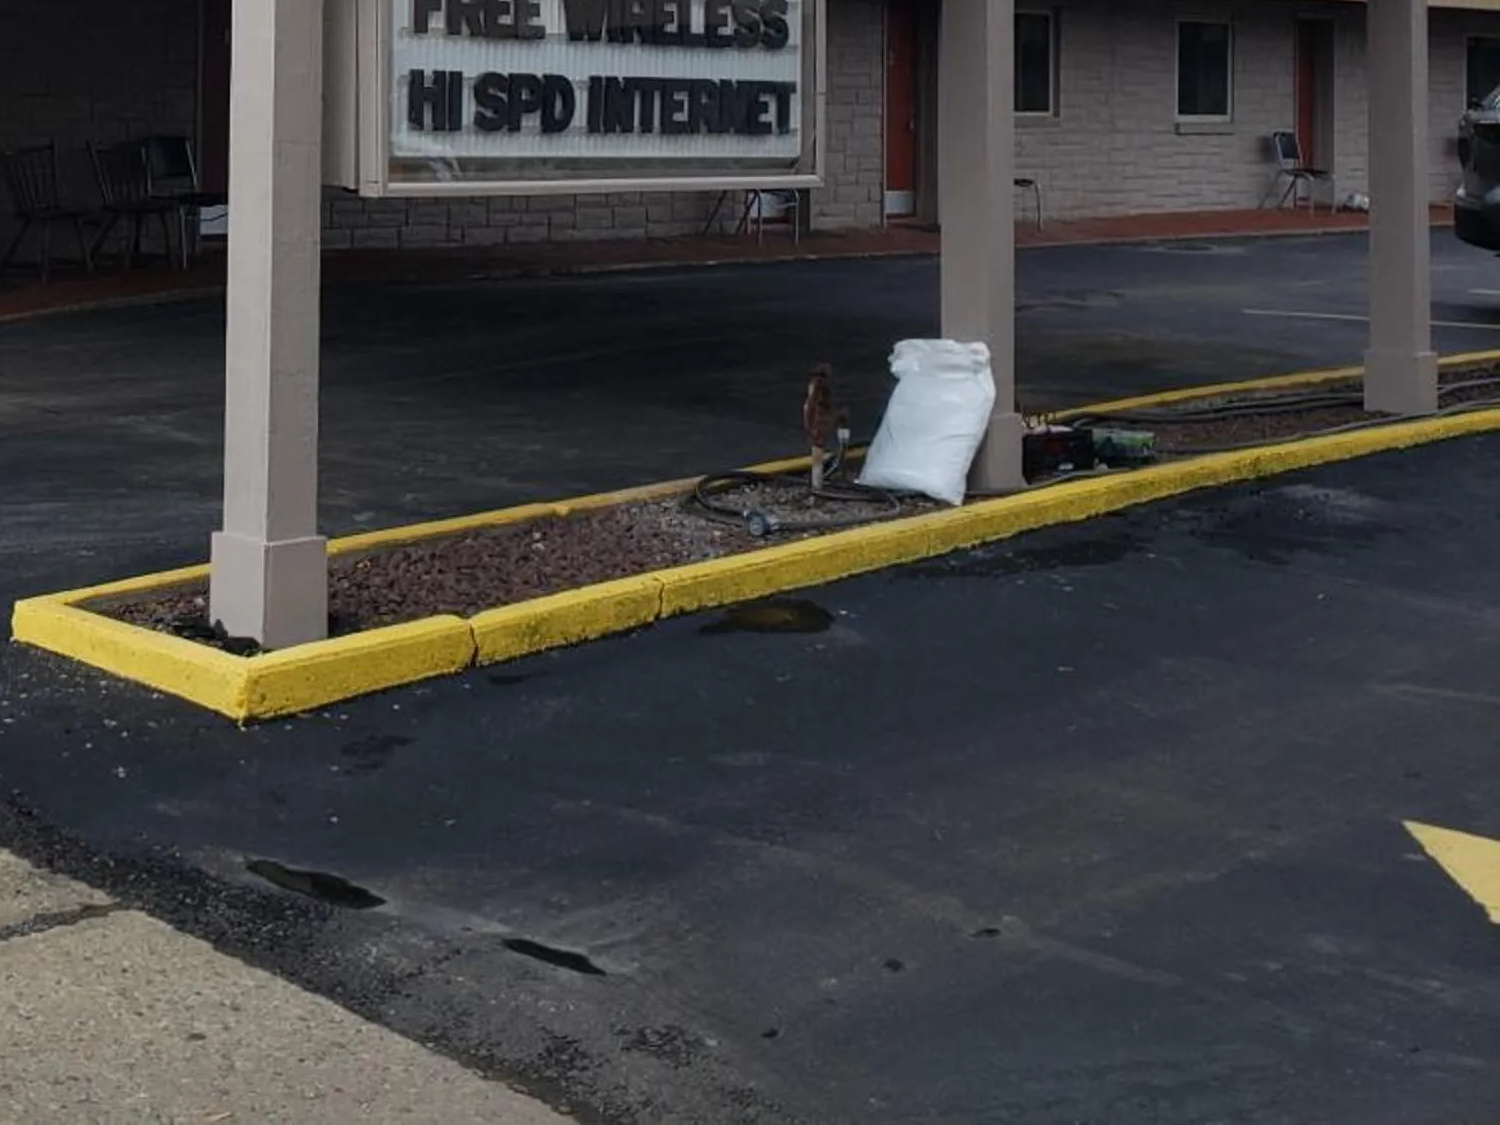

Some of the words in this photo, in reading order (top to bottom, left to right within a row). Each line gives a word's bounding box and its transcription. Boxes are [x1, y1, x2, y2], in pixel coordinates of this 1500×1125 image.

[407, 69, 463, 132] HI
[472, 71, 576, 133] SPD
[586, 75, 797, 135] INTERNET
